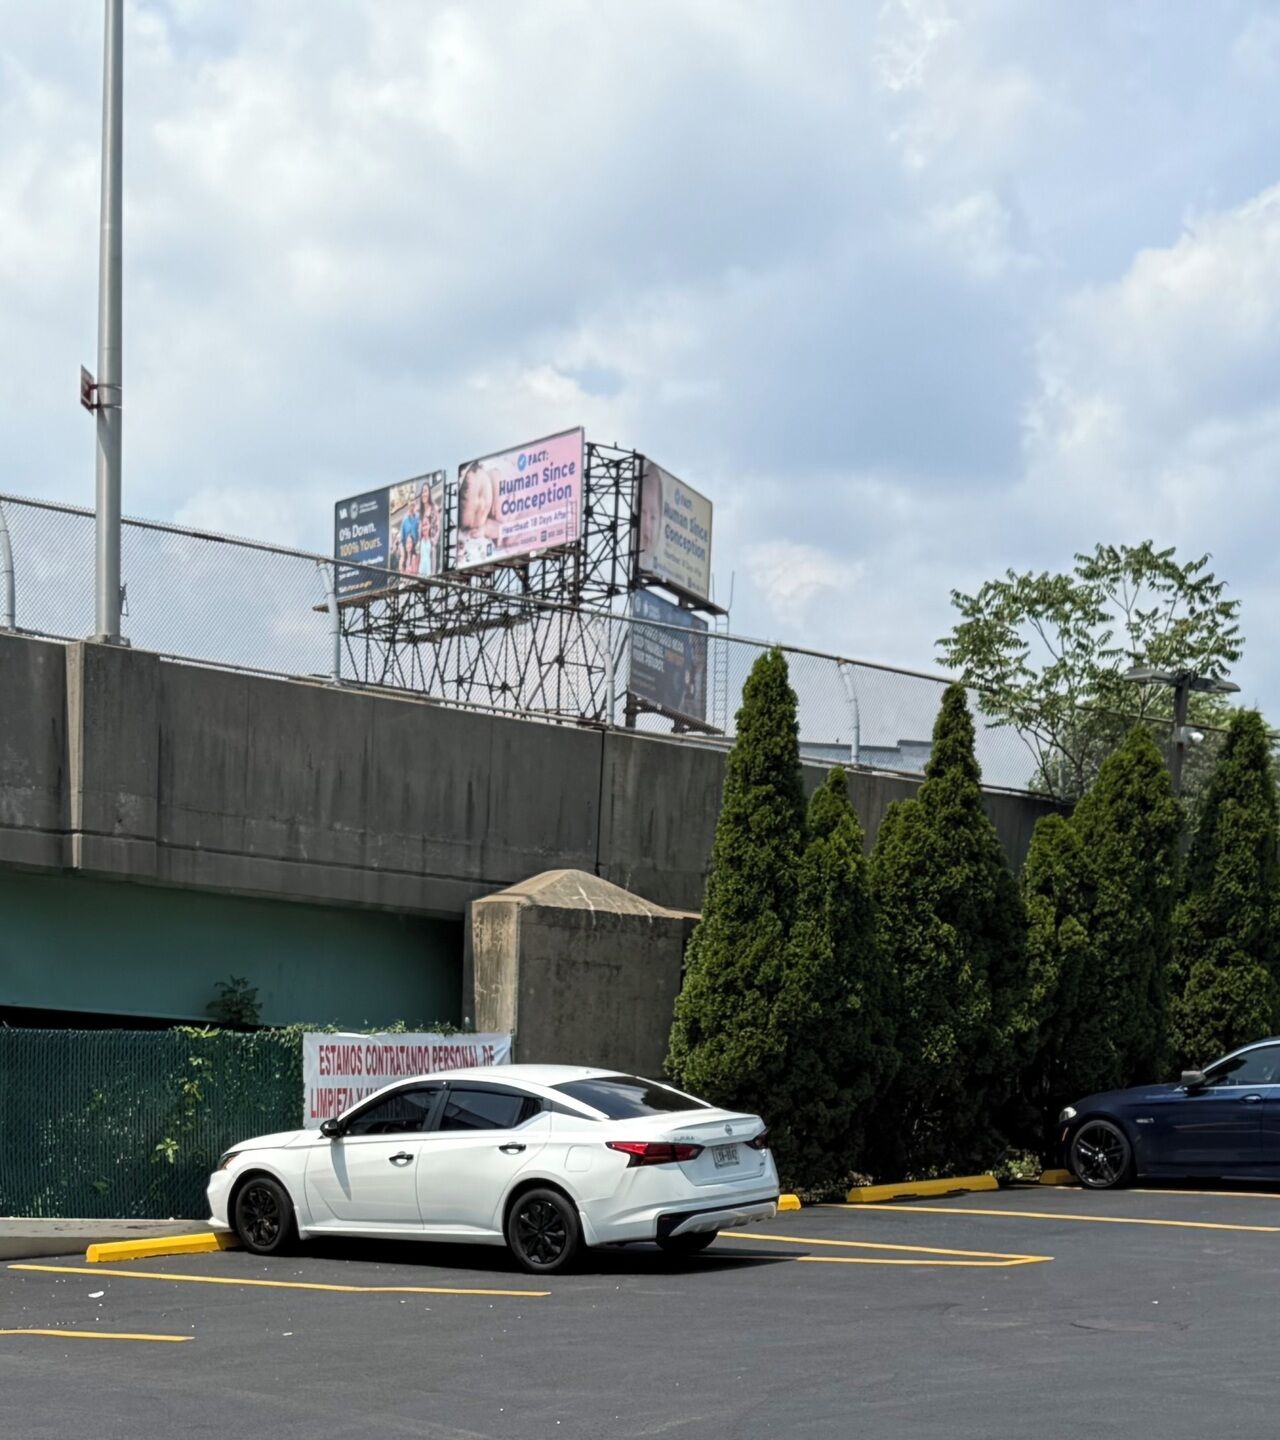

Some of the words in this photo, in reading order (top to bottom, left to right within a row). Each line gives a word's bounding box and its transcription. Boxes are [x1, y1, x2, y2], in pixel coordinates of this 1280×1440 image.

[528, 450, 549, 466] FACT:
[499, 473, 538, 496] Human
[542, 461, 575, 483] Since
[501, 482, 572, 516] Conception
[339, 527, 351, 541] 0%
[352, 523, 376, 538] Down.
[340, 542, 359, 557] 100%
[360, 537, 382, 551] Yours.
[665, 524, 705, 561] Conception
[319, 1045, 362, 1076] ESTAMOS
[365, 1045, 429, 1076] CONTRATANDO
[433, 1045, 478, 1073] PERSONAL
